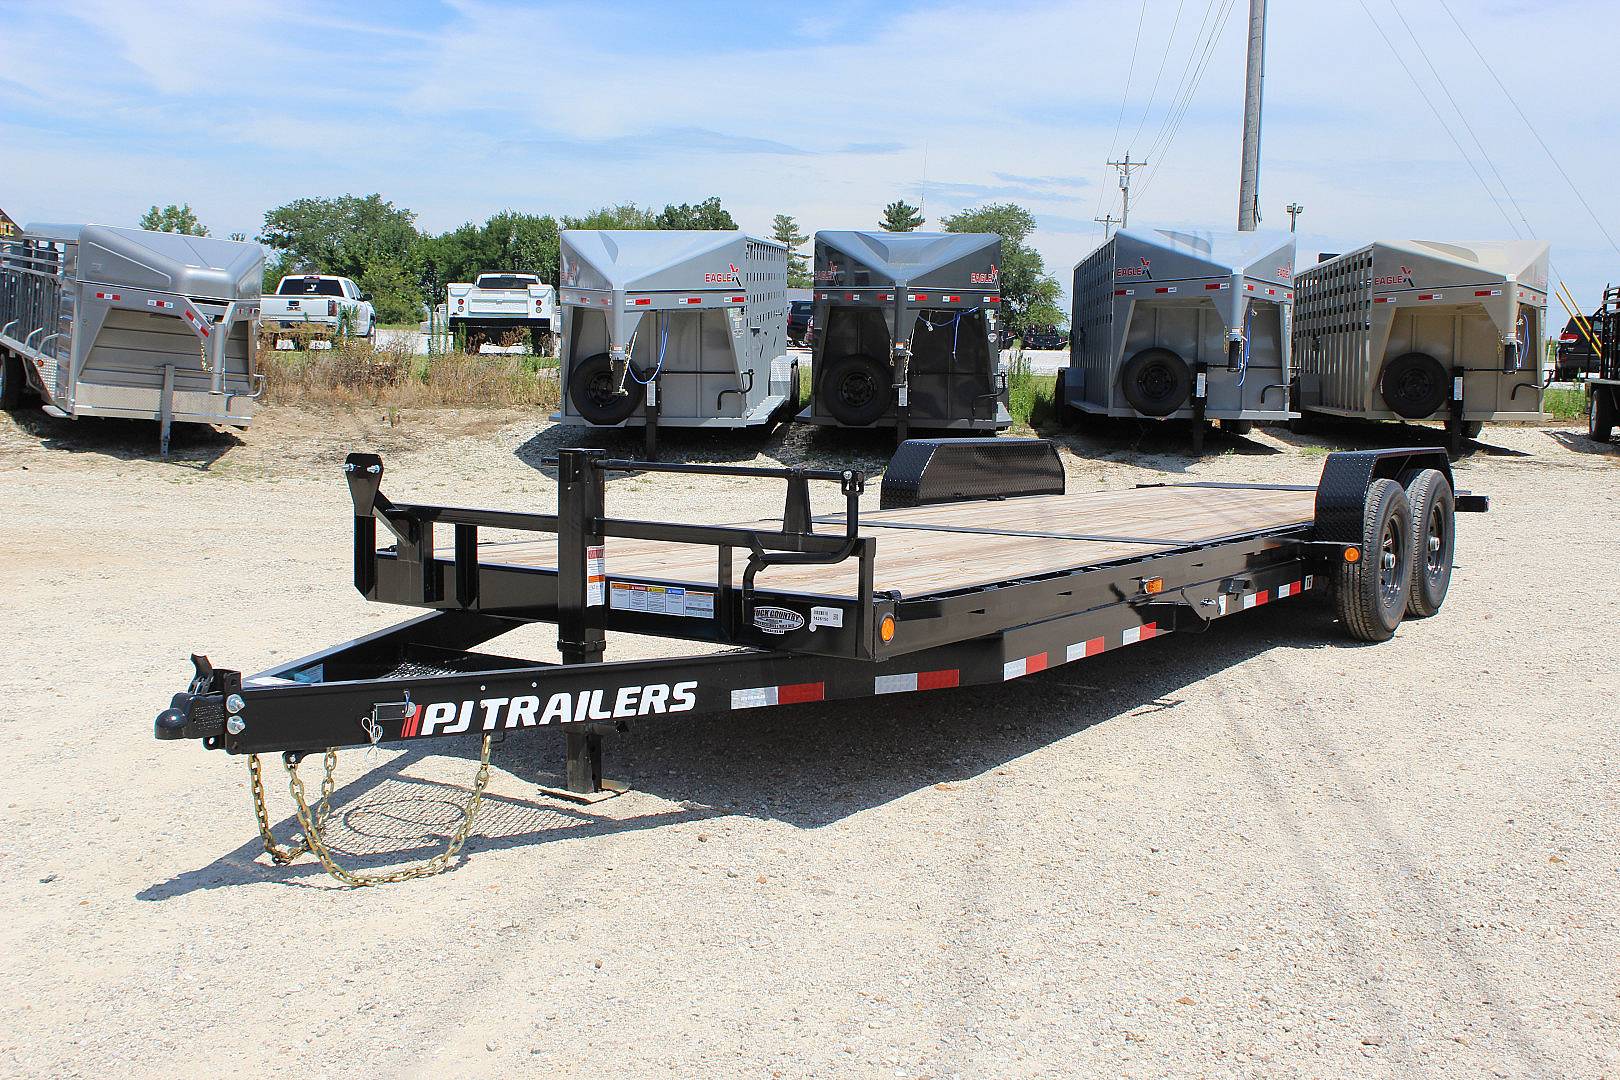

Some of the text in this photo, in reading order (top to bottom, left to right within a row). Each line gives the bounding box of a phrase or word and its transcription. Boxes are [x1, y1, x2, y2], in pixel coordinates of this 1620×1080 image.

[770, 609, 800, 622] COUNTRY
[420, 680, 698, 736] PJ TRAILERS
